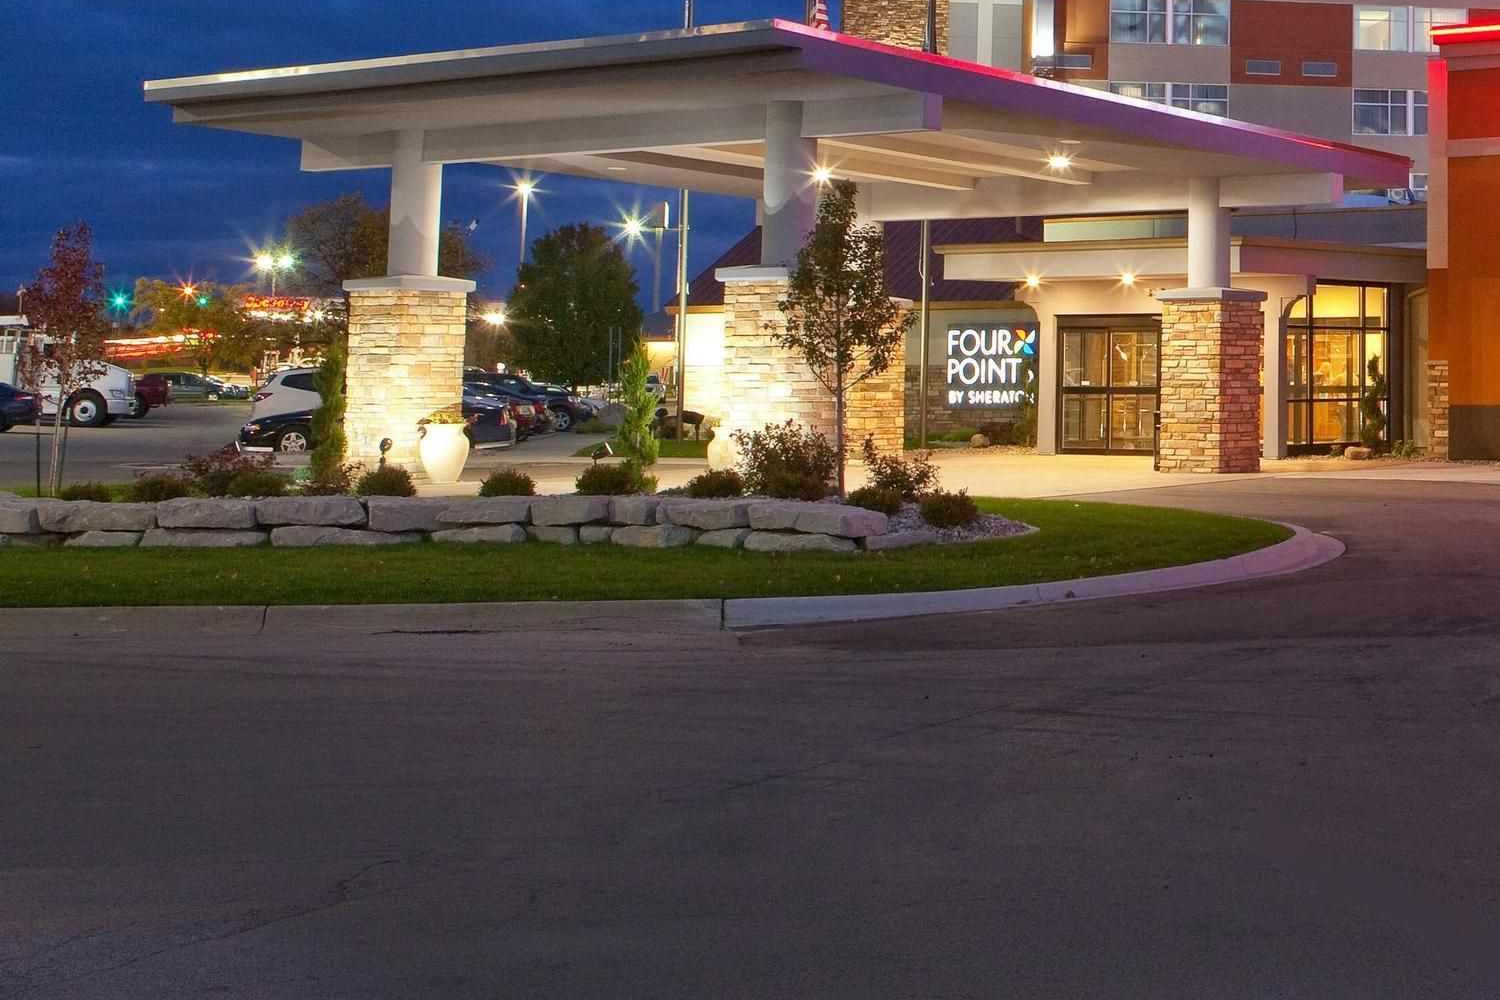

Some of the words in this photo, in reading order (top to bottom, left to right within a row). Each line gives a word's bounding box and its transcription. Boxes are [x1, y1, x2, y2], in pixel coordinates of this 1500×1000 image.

[947, 329, 1014, 356] FOUR
[947, 358, 1034, 385] POINT
[948, 390, 964, 404] BY
